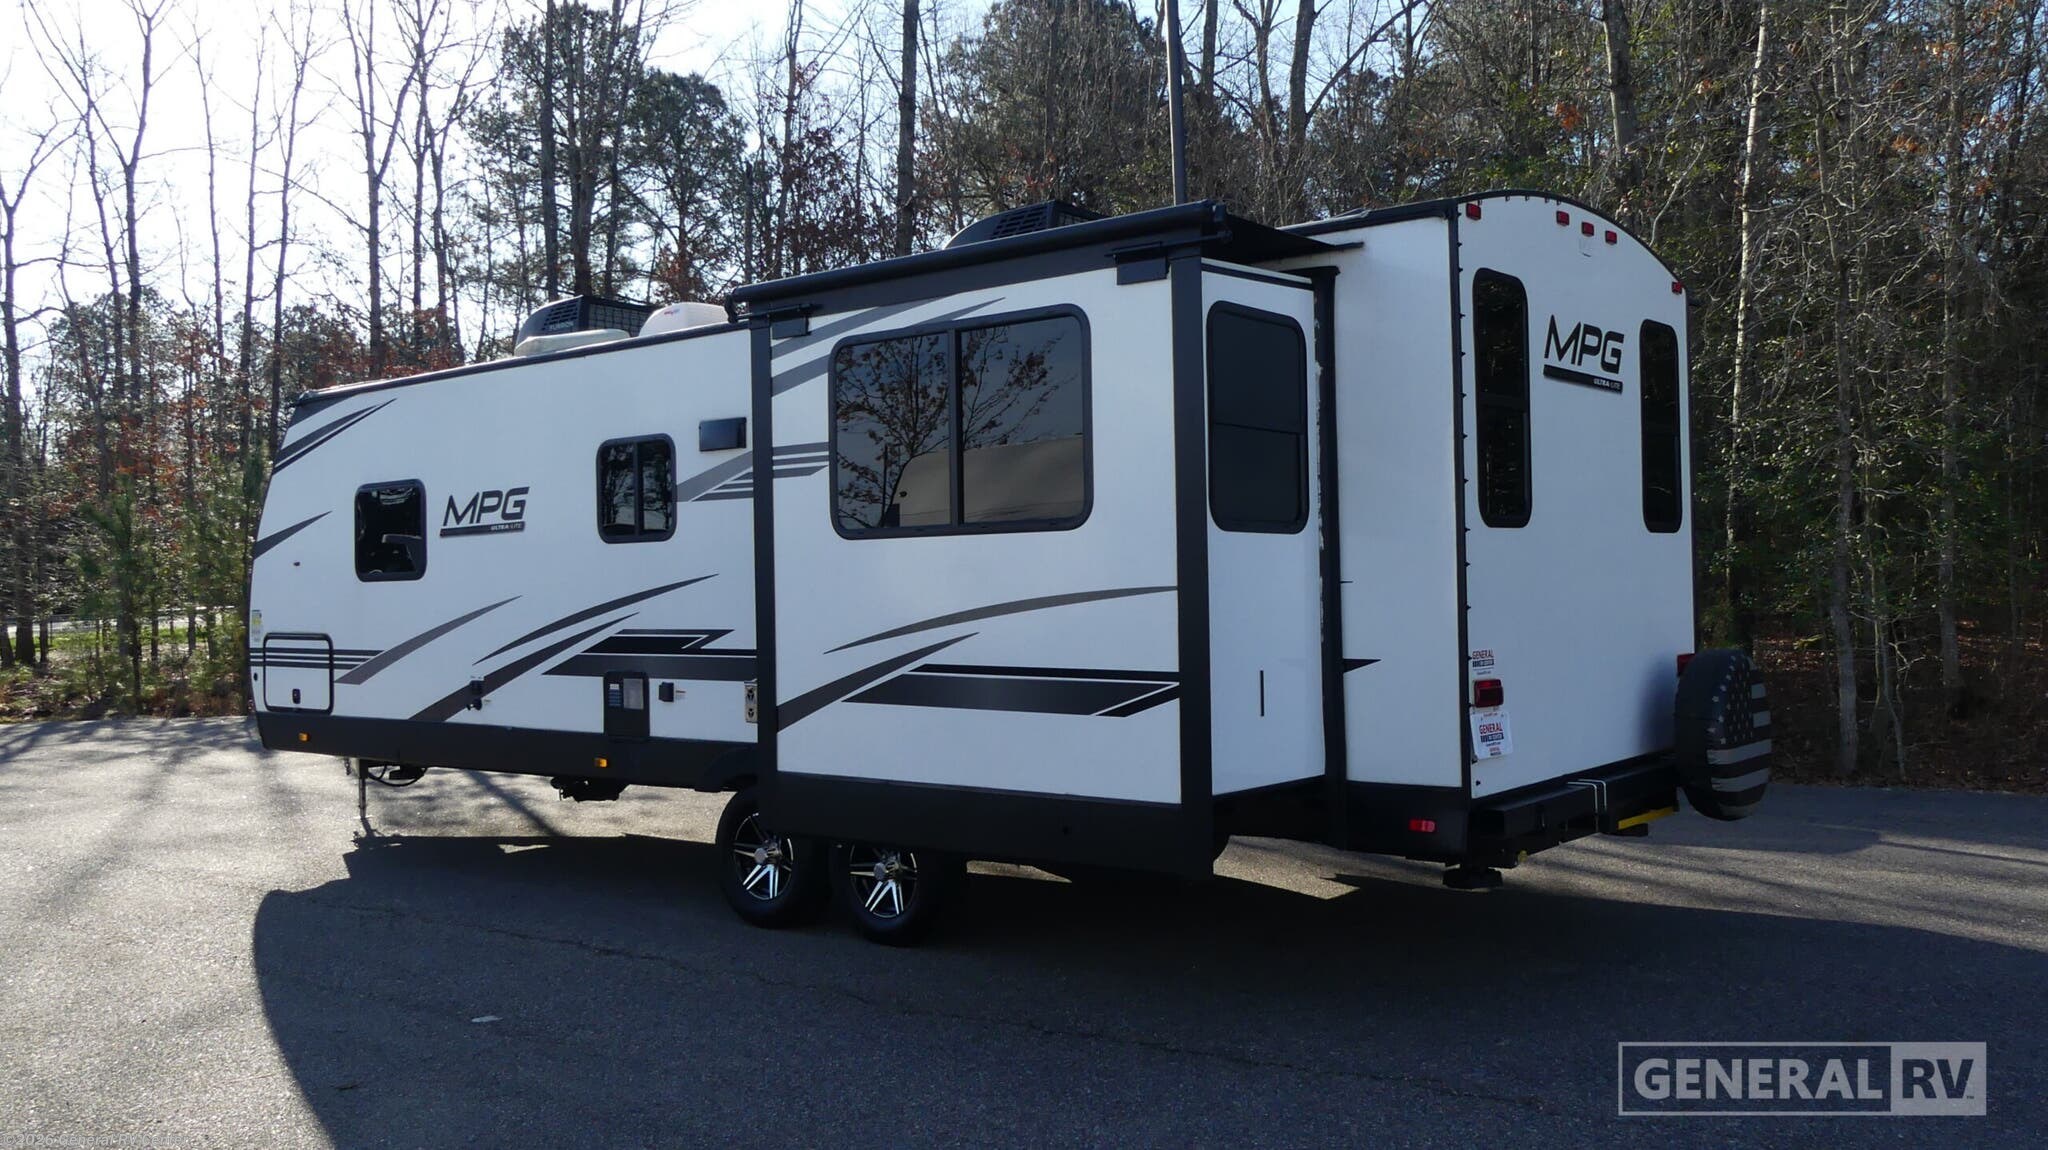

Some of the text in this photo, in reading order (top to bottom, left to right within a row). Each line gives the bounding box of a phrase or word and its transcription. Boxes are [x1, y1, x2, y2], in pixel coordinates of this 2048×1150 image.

[1544, 314, 1625, 375] MPG
[443, 486, 530, 526] MPG
[1472, 649, 1494, 659] GENERAL
[1479, 722, 1503, 735] GENERAL
